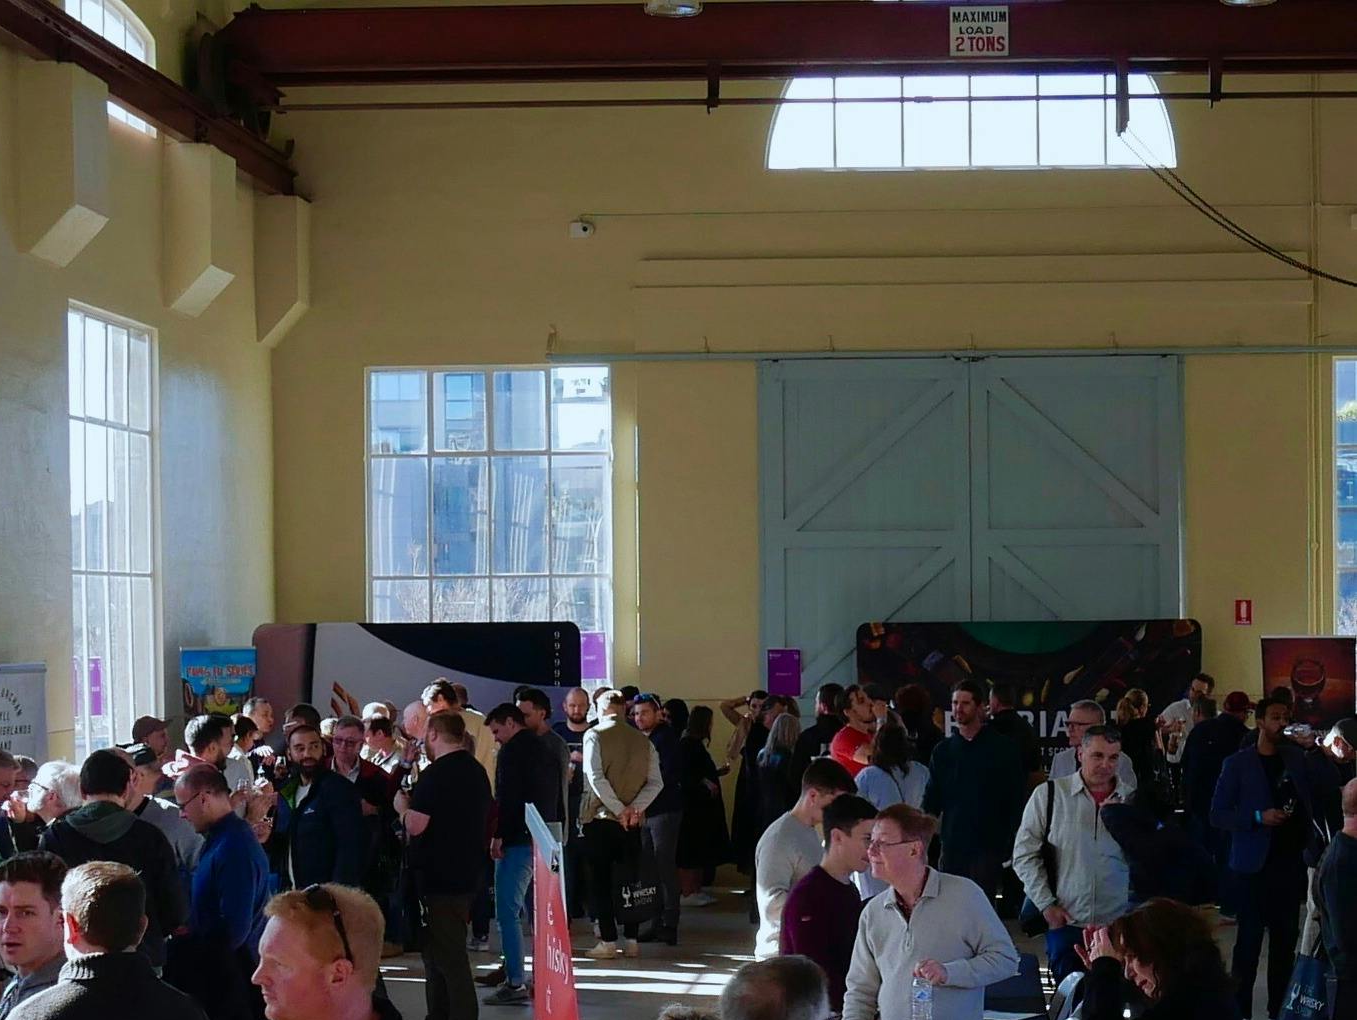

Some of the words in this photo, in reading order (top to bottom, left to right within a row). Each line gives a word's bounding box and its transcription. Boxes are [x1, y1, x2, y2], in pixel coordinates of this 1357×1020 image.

[952, 11, 1006, 23] MAXIMUM
[959, 26, 994, 35] LOAD
[955, 37, 965, 52] 2
[967, 36, 1006, 52] TONS
[546, 933, 569, 985] hisky
